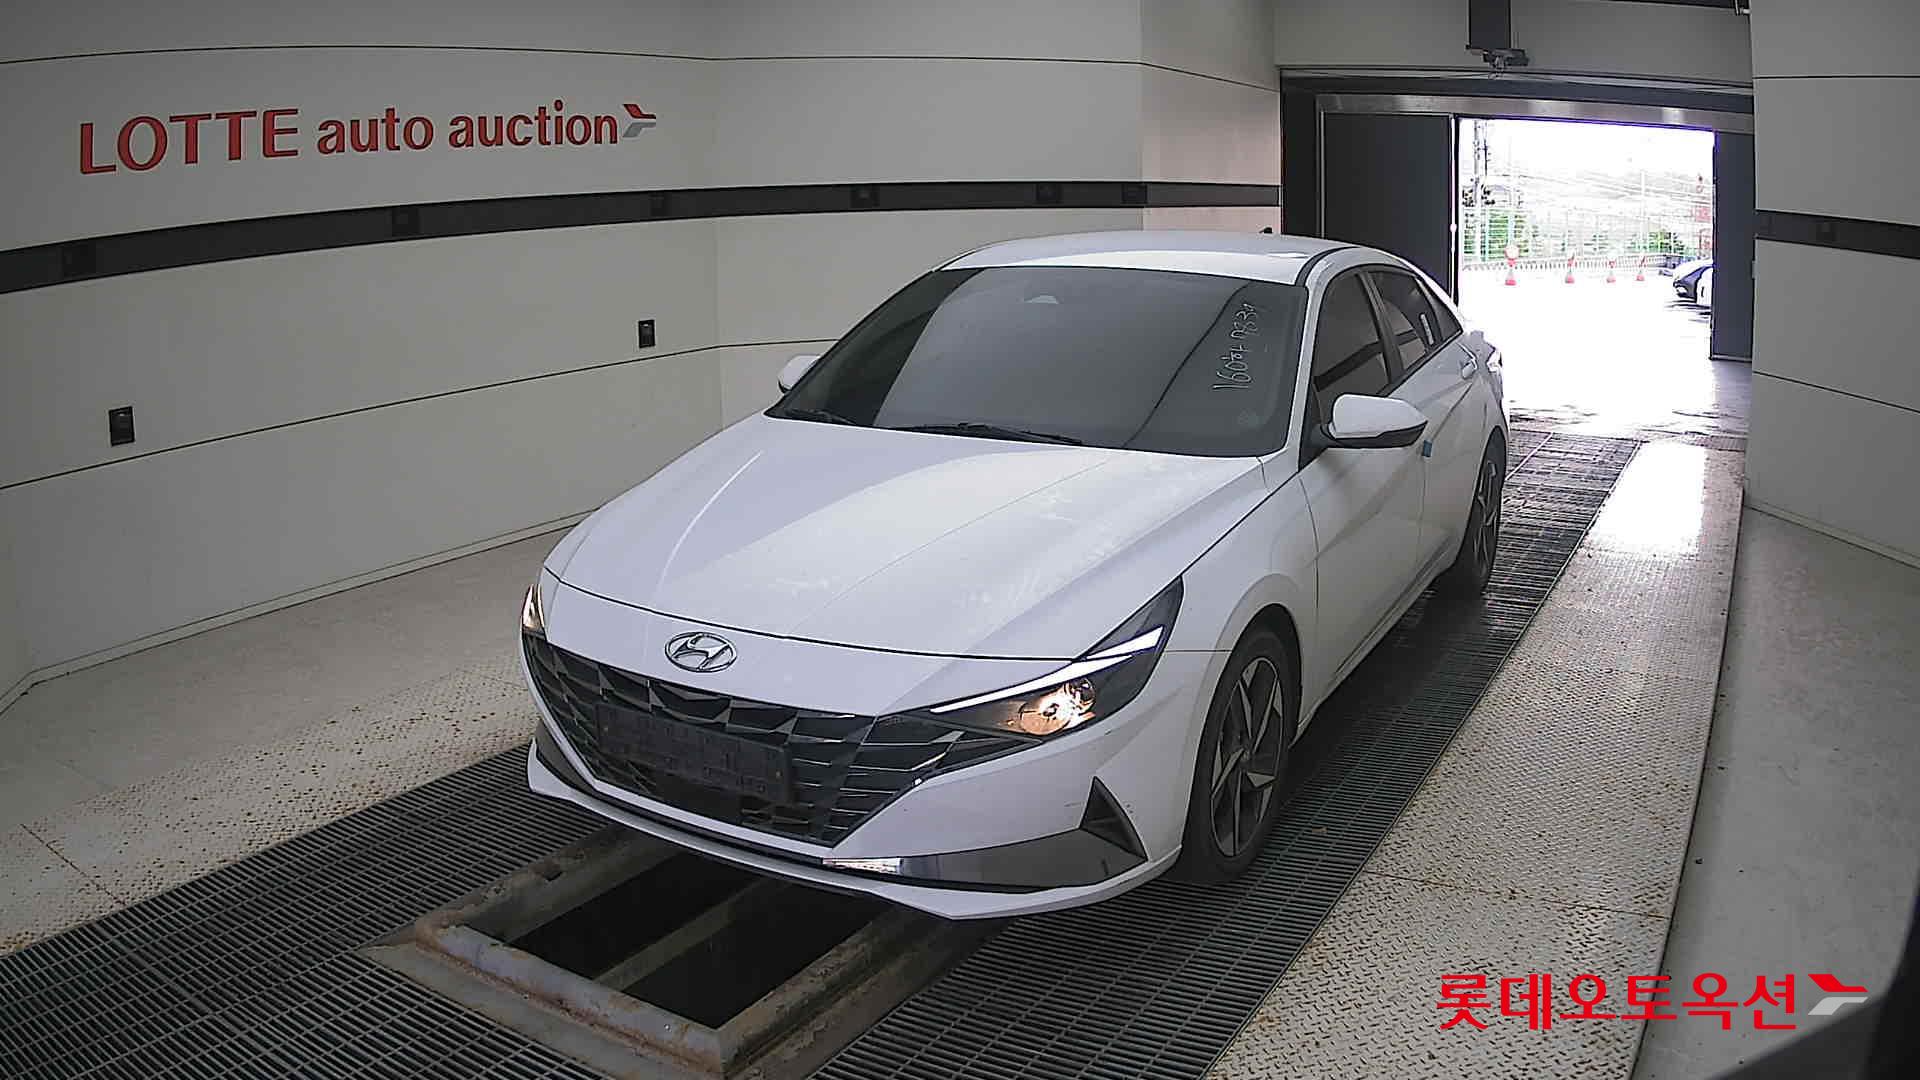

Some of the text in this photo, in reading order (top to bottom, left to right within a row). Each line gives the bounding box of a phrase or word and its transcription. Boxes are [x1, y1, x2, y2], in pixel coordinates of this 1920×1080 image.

[80, 100, 619, 175] LOTTE auto auction
